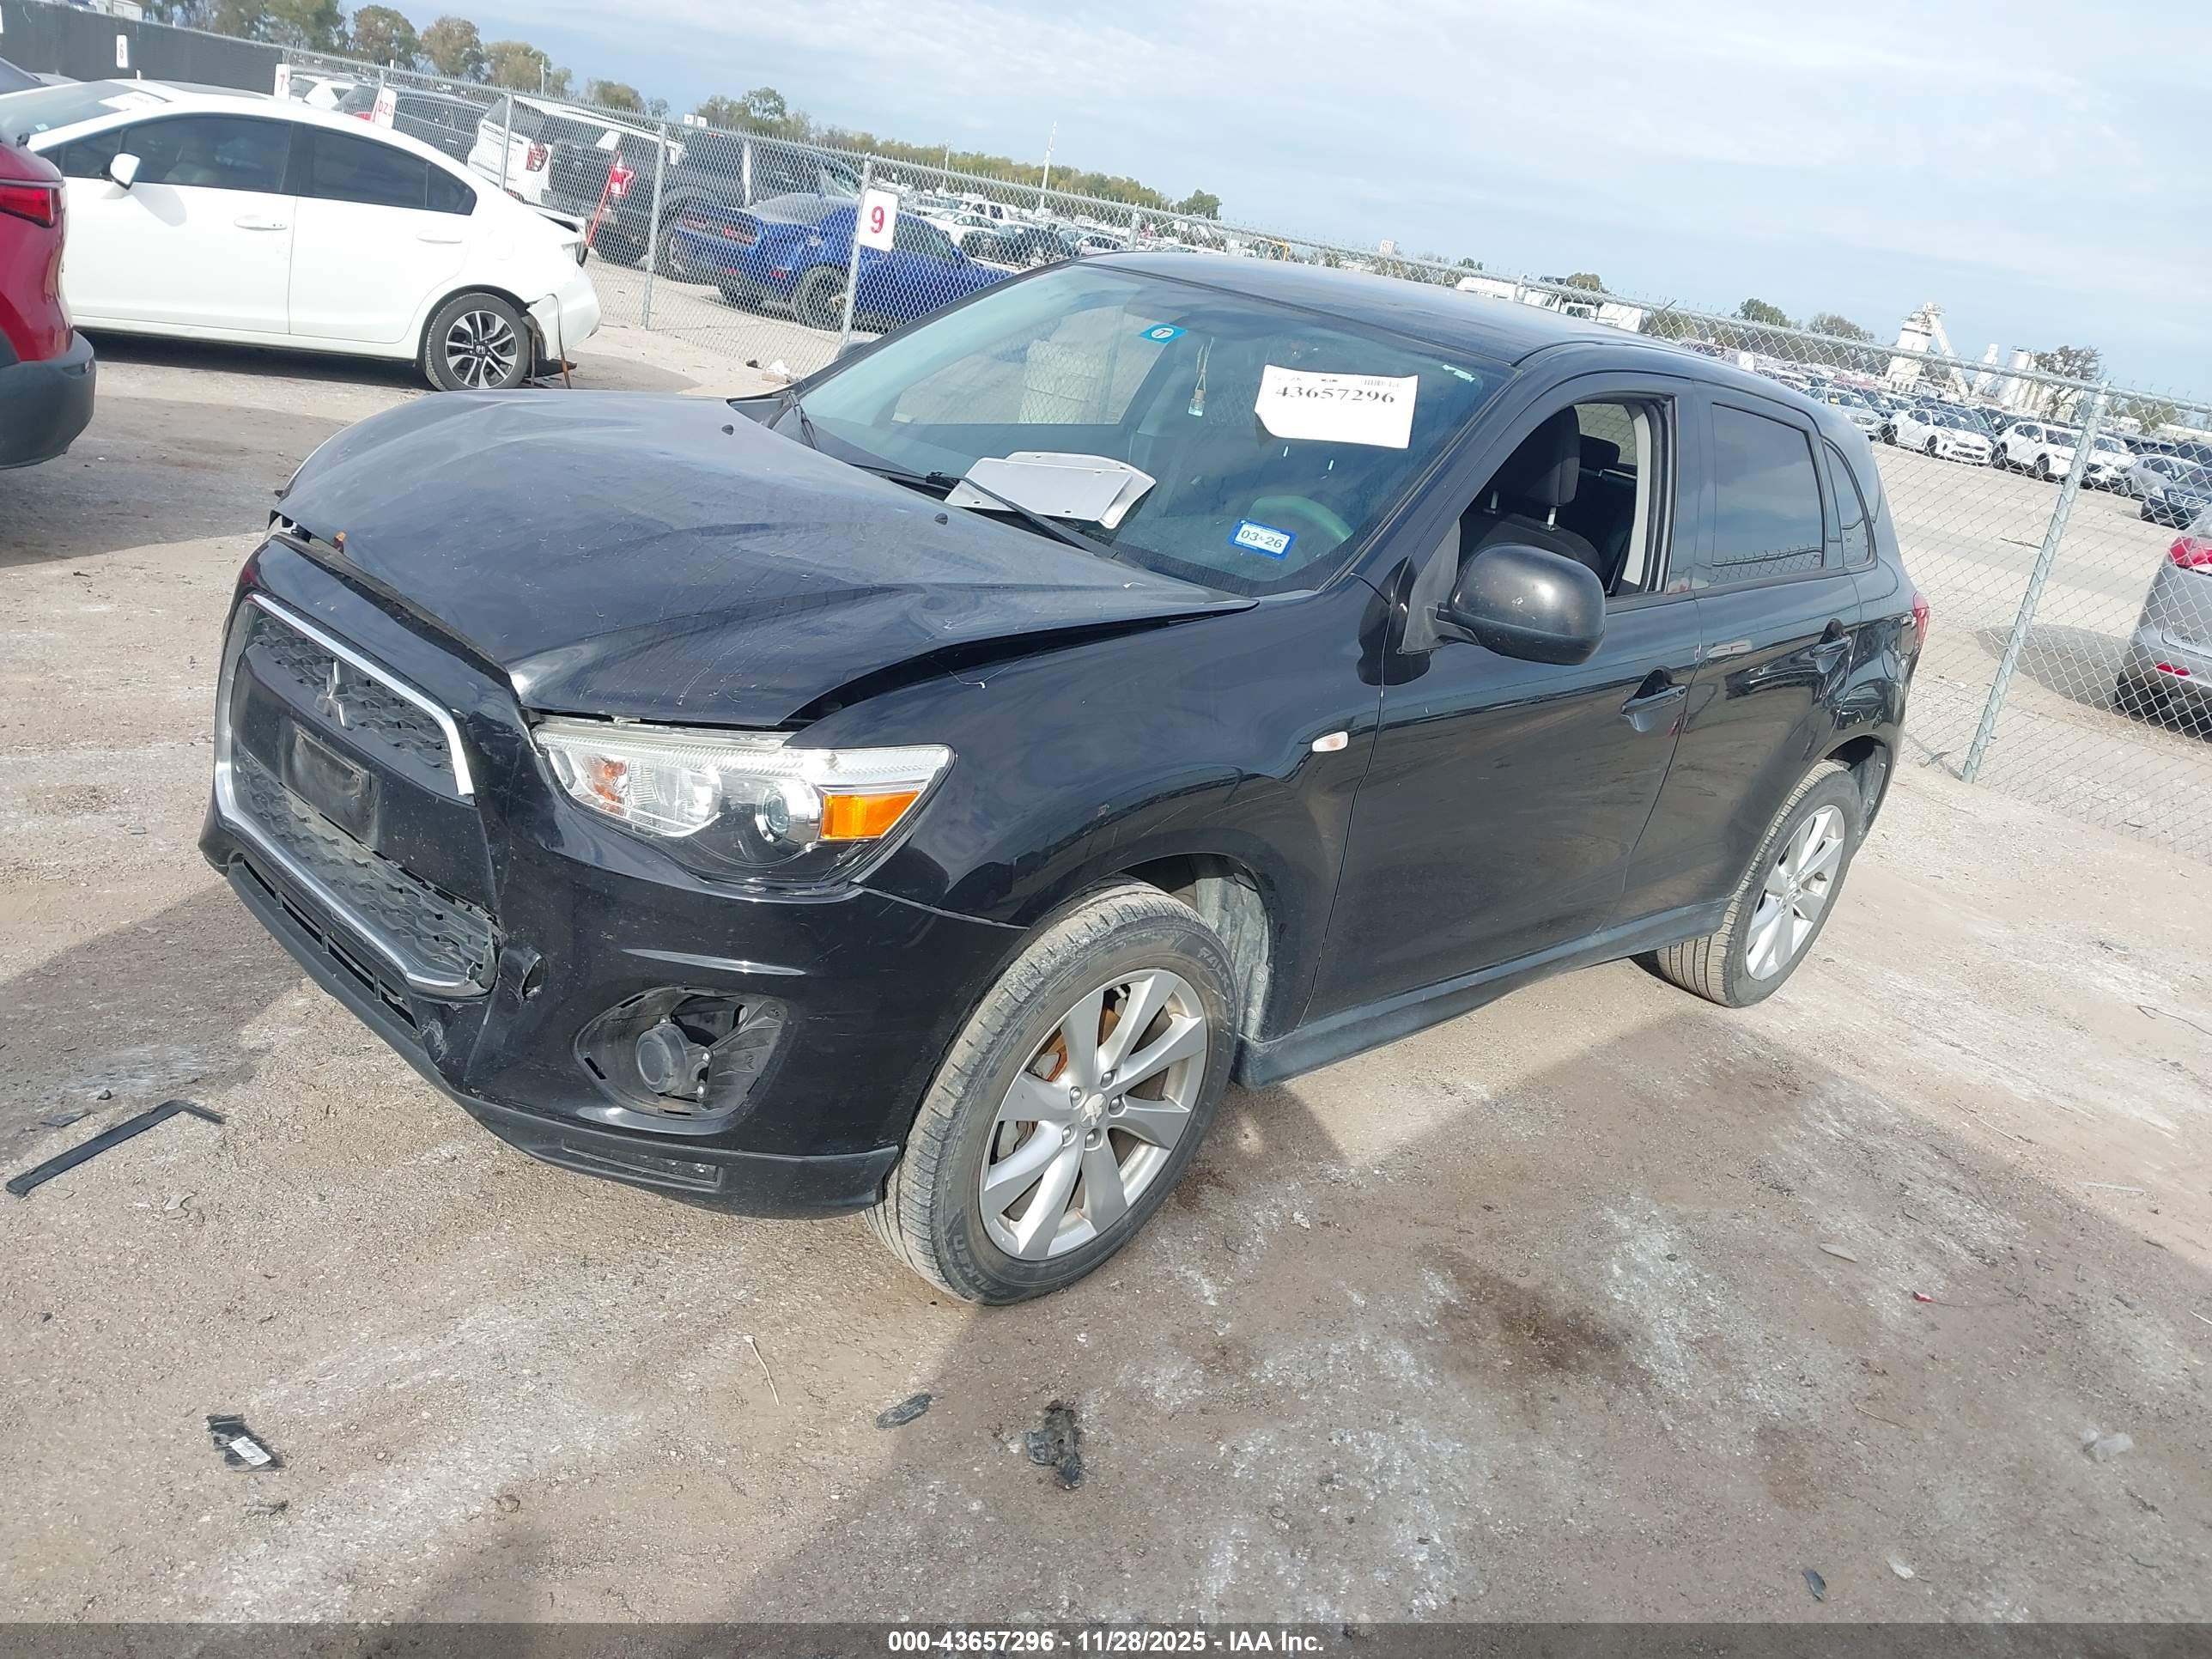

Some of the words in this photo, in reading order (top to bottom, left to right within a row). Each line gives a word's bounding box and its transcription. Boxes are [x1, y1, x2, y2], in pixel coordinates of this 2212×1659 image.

[119, 43, 125, 60] 6
[280, 74, 286, 92] 7
[871, 205, 884, 234] 9
[1275, 386, 1395, 404] 43657296
